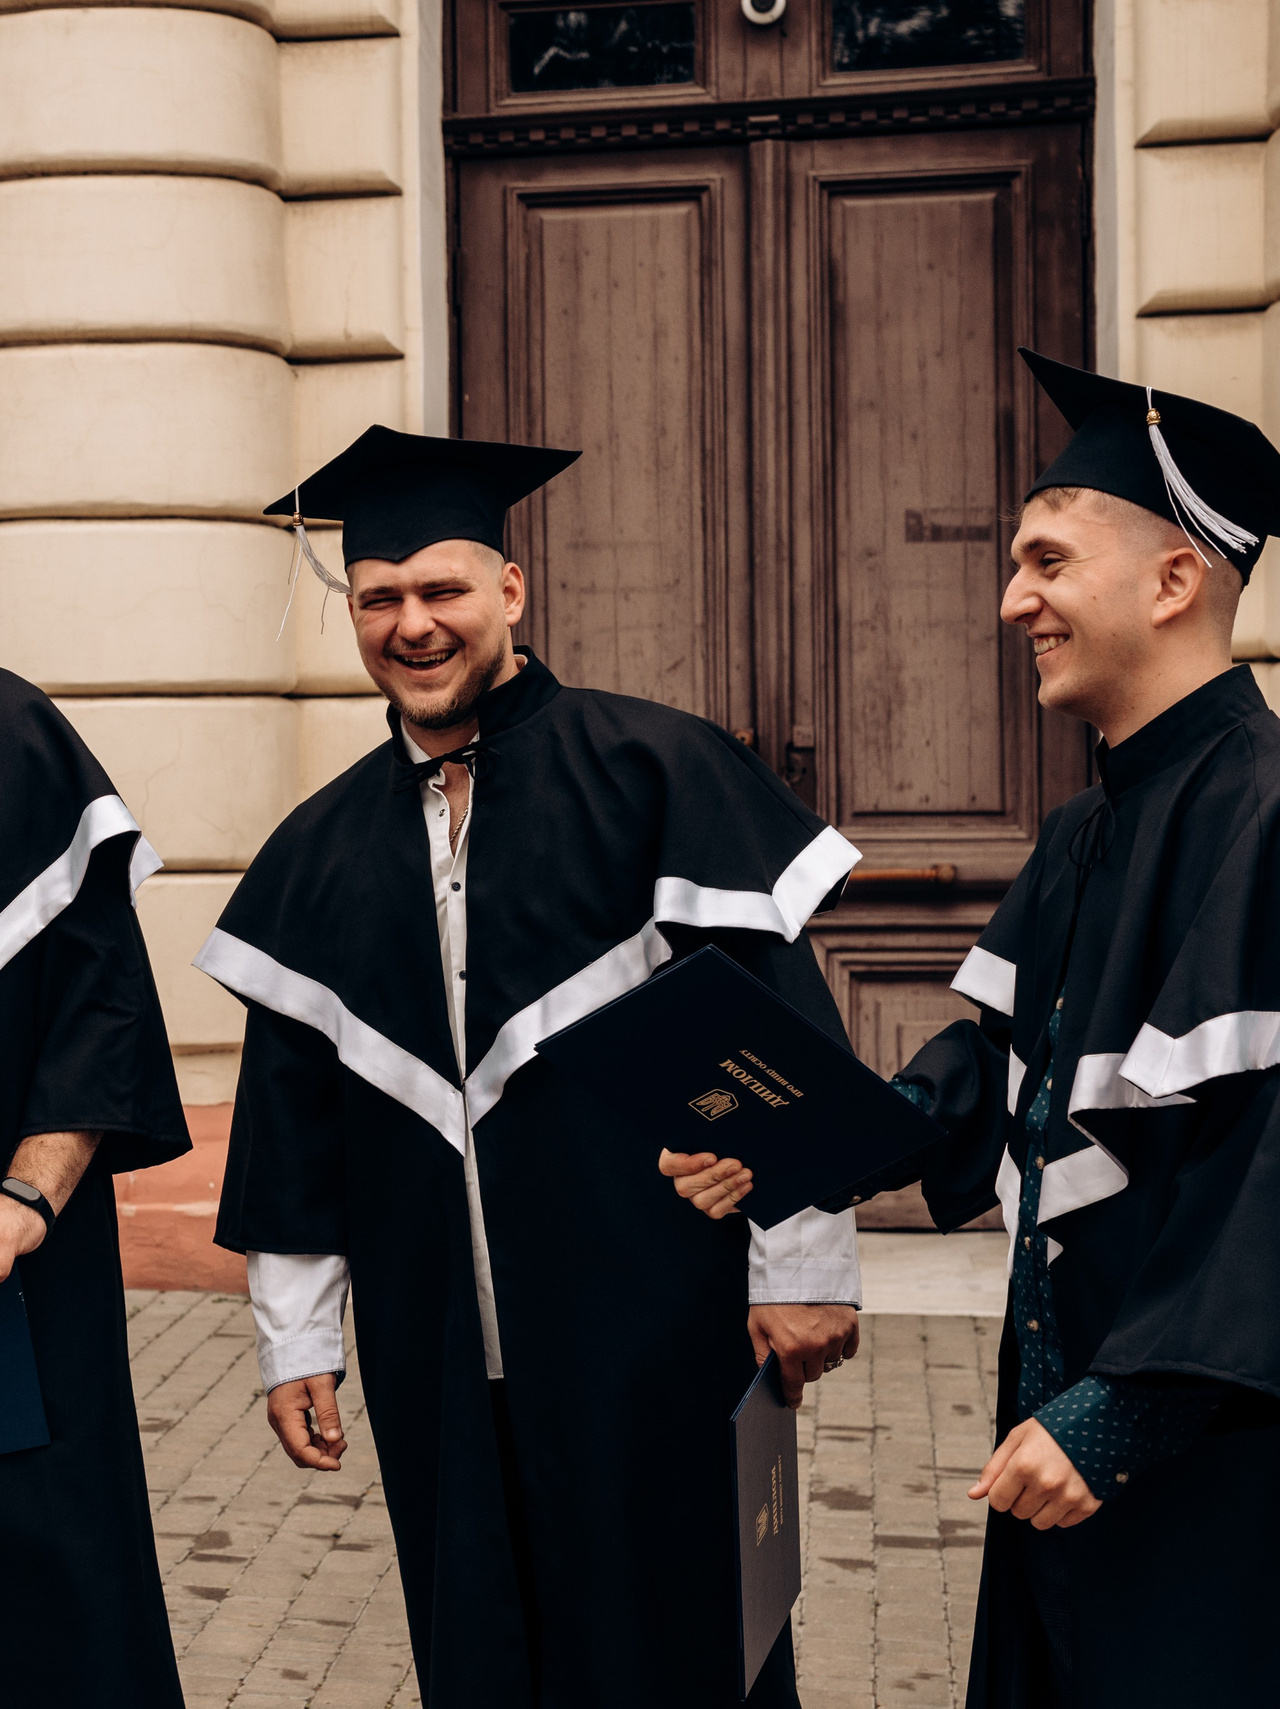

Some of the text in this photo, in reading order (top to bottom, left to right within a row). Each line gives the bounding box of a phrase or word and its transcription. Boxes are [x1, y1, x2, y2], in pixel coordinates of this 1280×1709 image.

[719, 1058, 790, 1108] ДИПЛОМ
[739, 1049, 804, 1098] ПРО ВИЩУ ОСВІТУ
